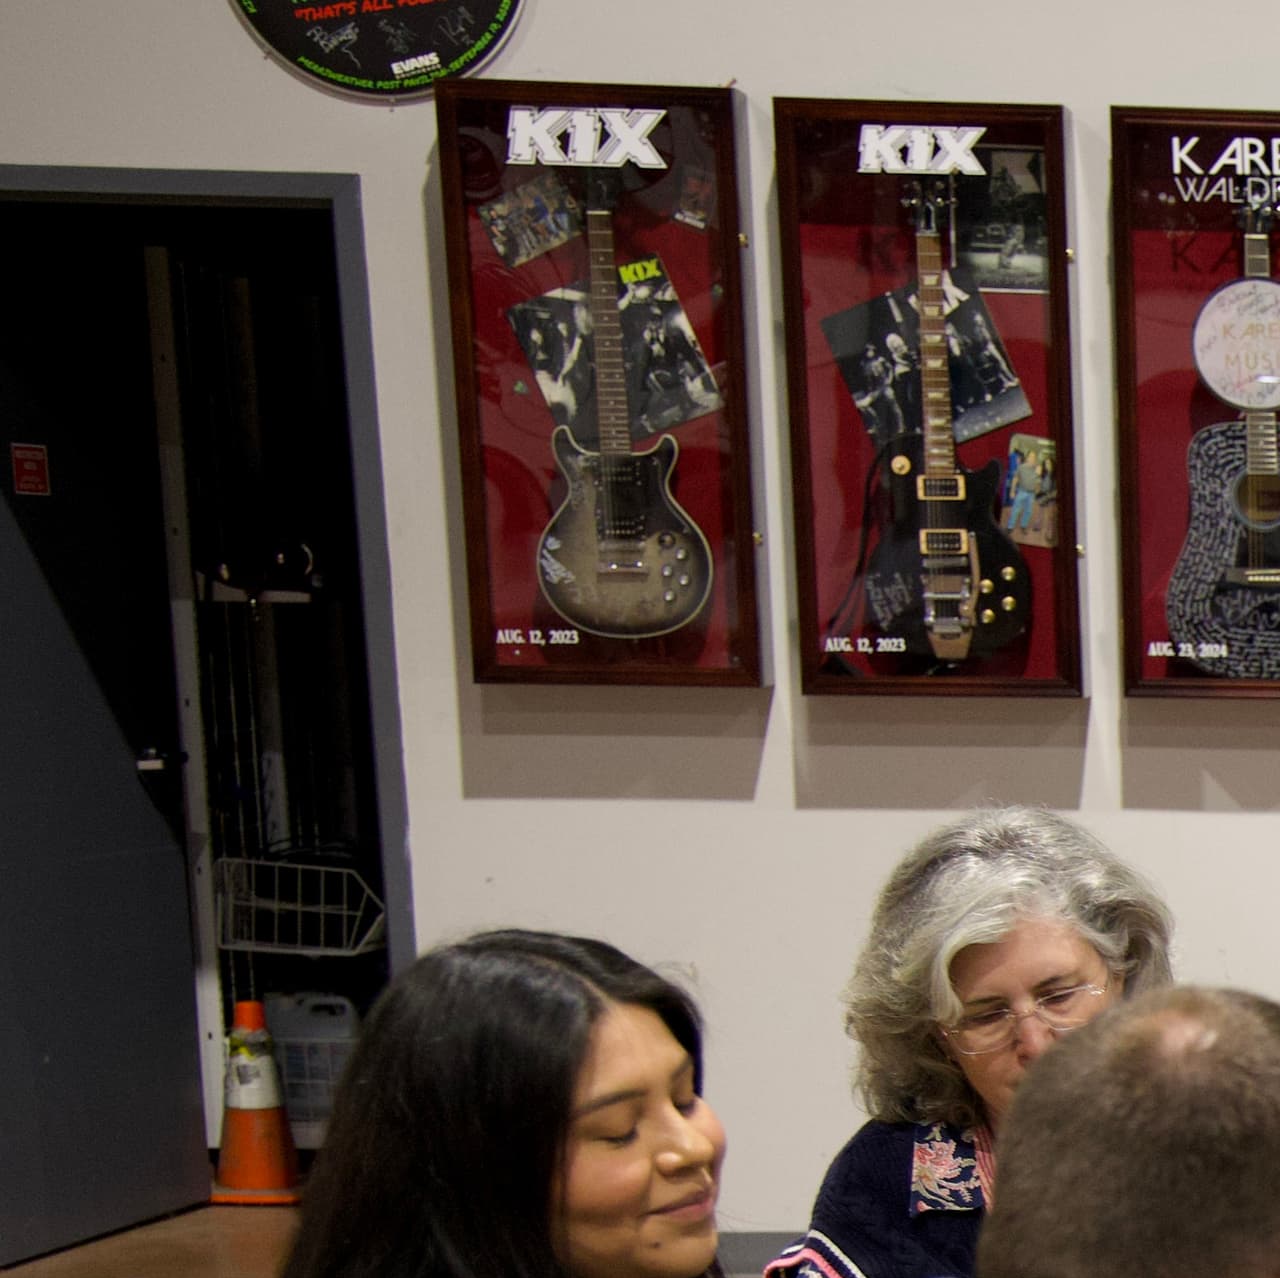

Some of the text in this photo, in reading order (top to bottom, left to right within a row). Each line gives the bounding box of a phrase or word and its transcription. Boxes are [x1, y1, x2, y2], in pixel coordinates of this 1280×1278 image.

[391, 52, 440, 75] EVANS
[506, 105, 668, 169] KIX
[857, 124, 987, 175] KIX
[619, 258, 662, 284] KIX
[496, 629, 579, 646] AUG. 12, 2023
[824, 637, 907, 654] AUG. 12, 2023
[1148, 641, 1177, 657] AUG.
